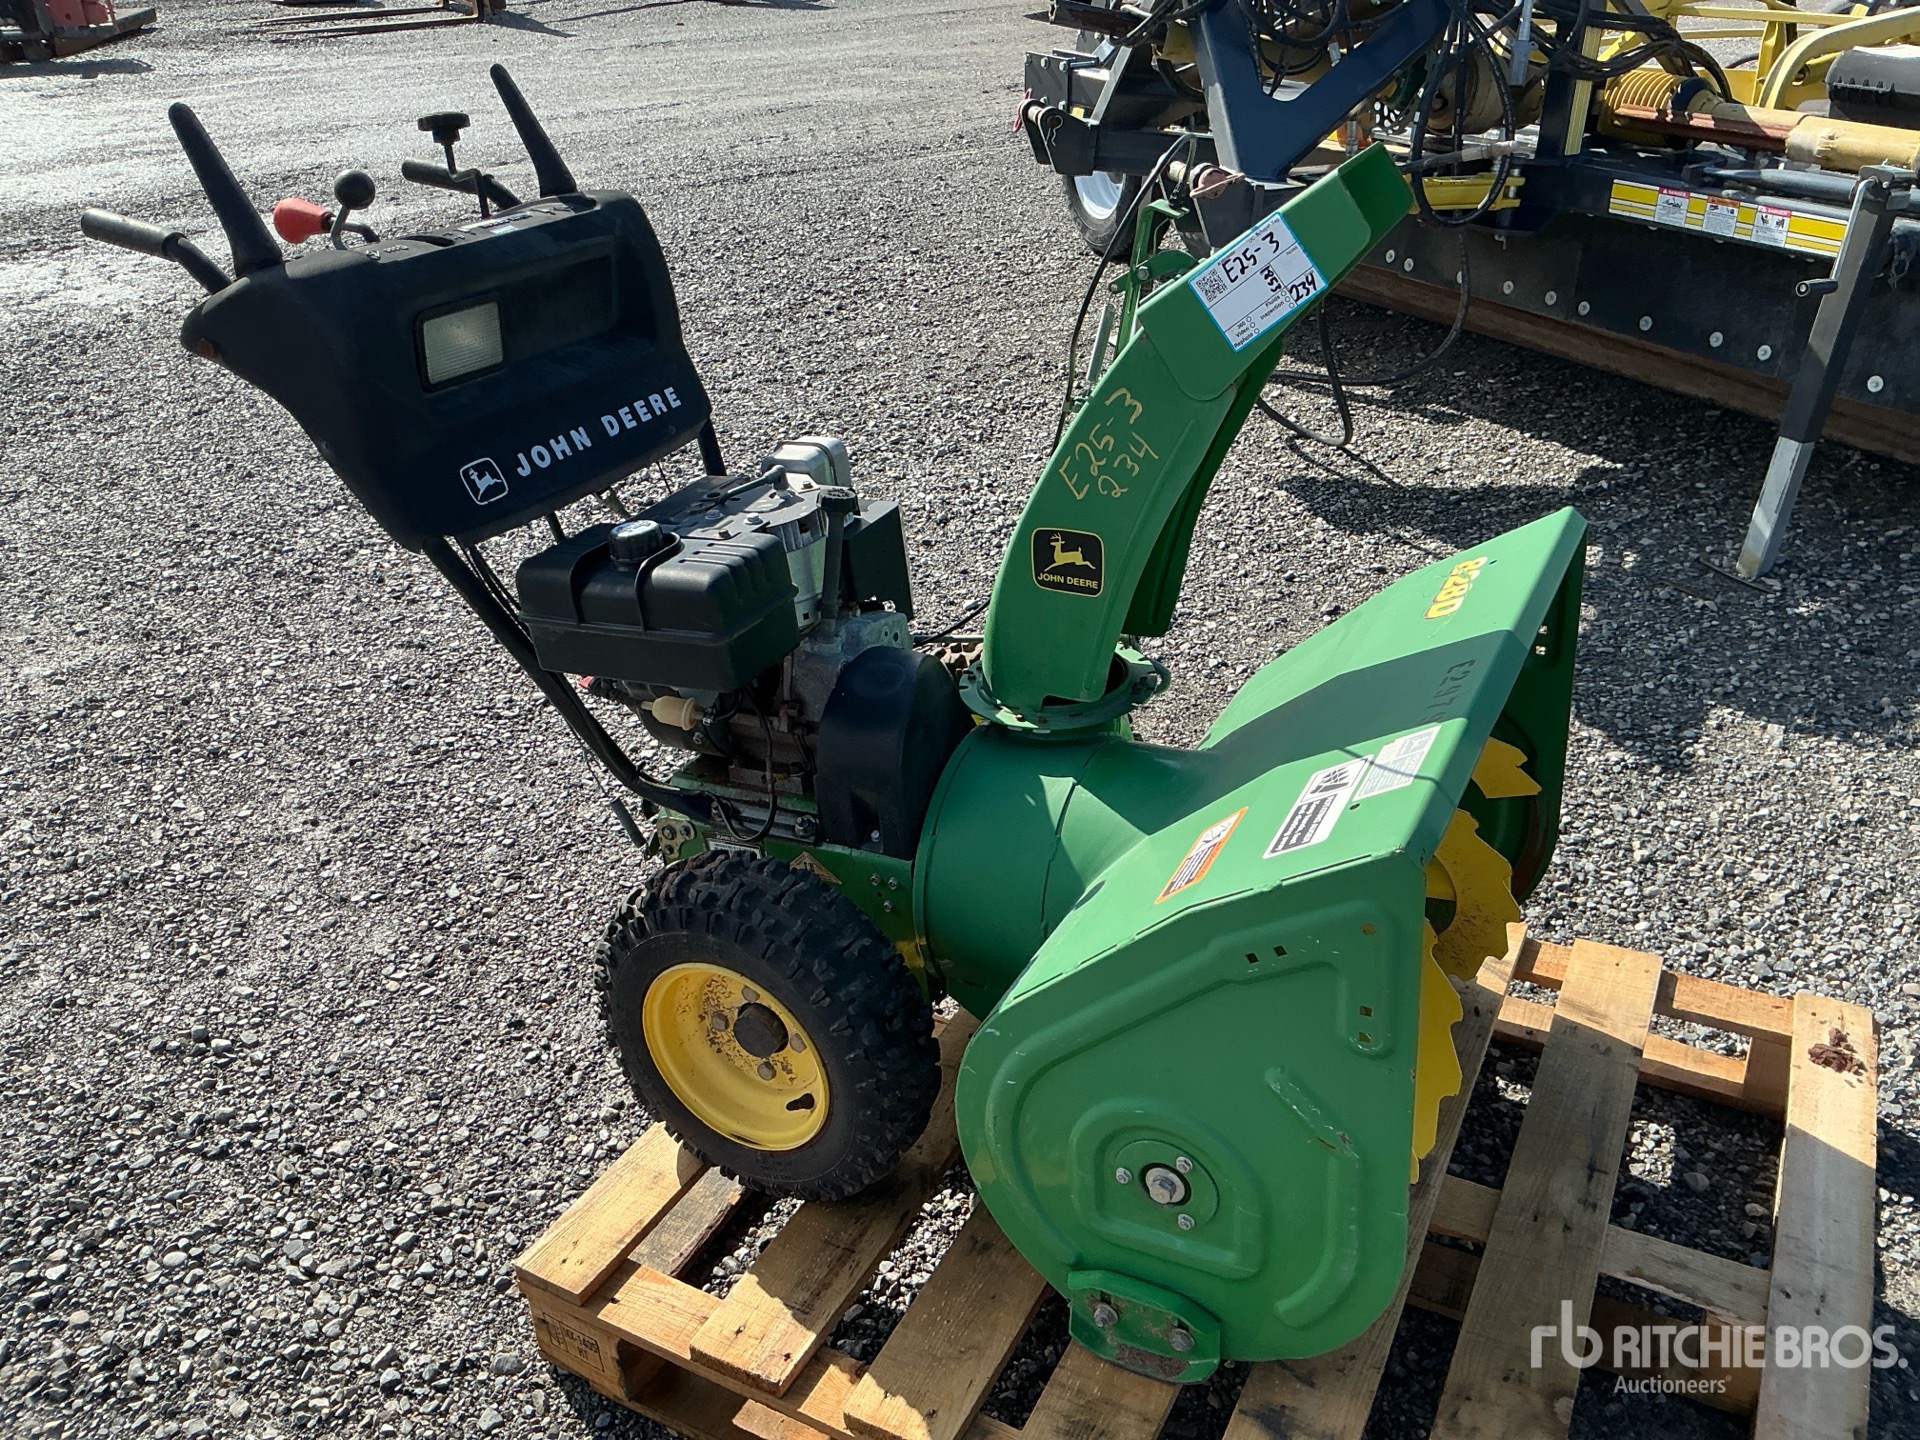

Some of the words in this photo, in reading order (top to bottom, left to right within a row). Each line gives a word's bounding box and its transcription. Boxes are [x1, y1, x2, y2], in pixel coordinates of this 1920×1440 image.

[1221, 231, 1280, 284] E25-3
[1264, 294, 1281, 309] Fluids
[1288, 272, 1318, 303] 234
[1259, 300, 1285, 321] Inspection
[1235, 326, 1250, 338] Video
[516, 426, 592, 477] JOHN
[601, 386, 682, 437] DEERE
[1058, 387, 1143, 500] E25-3
[1097, 431, 1159, 498] 234
[1037, 572, 1065, 583] JOHN
[1066, 575, 1099, 589] DEERE
